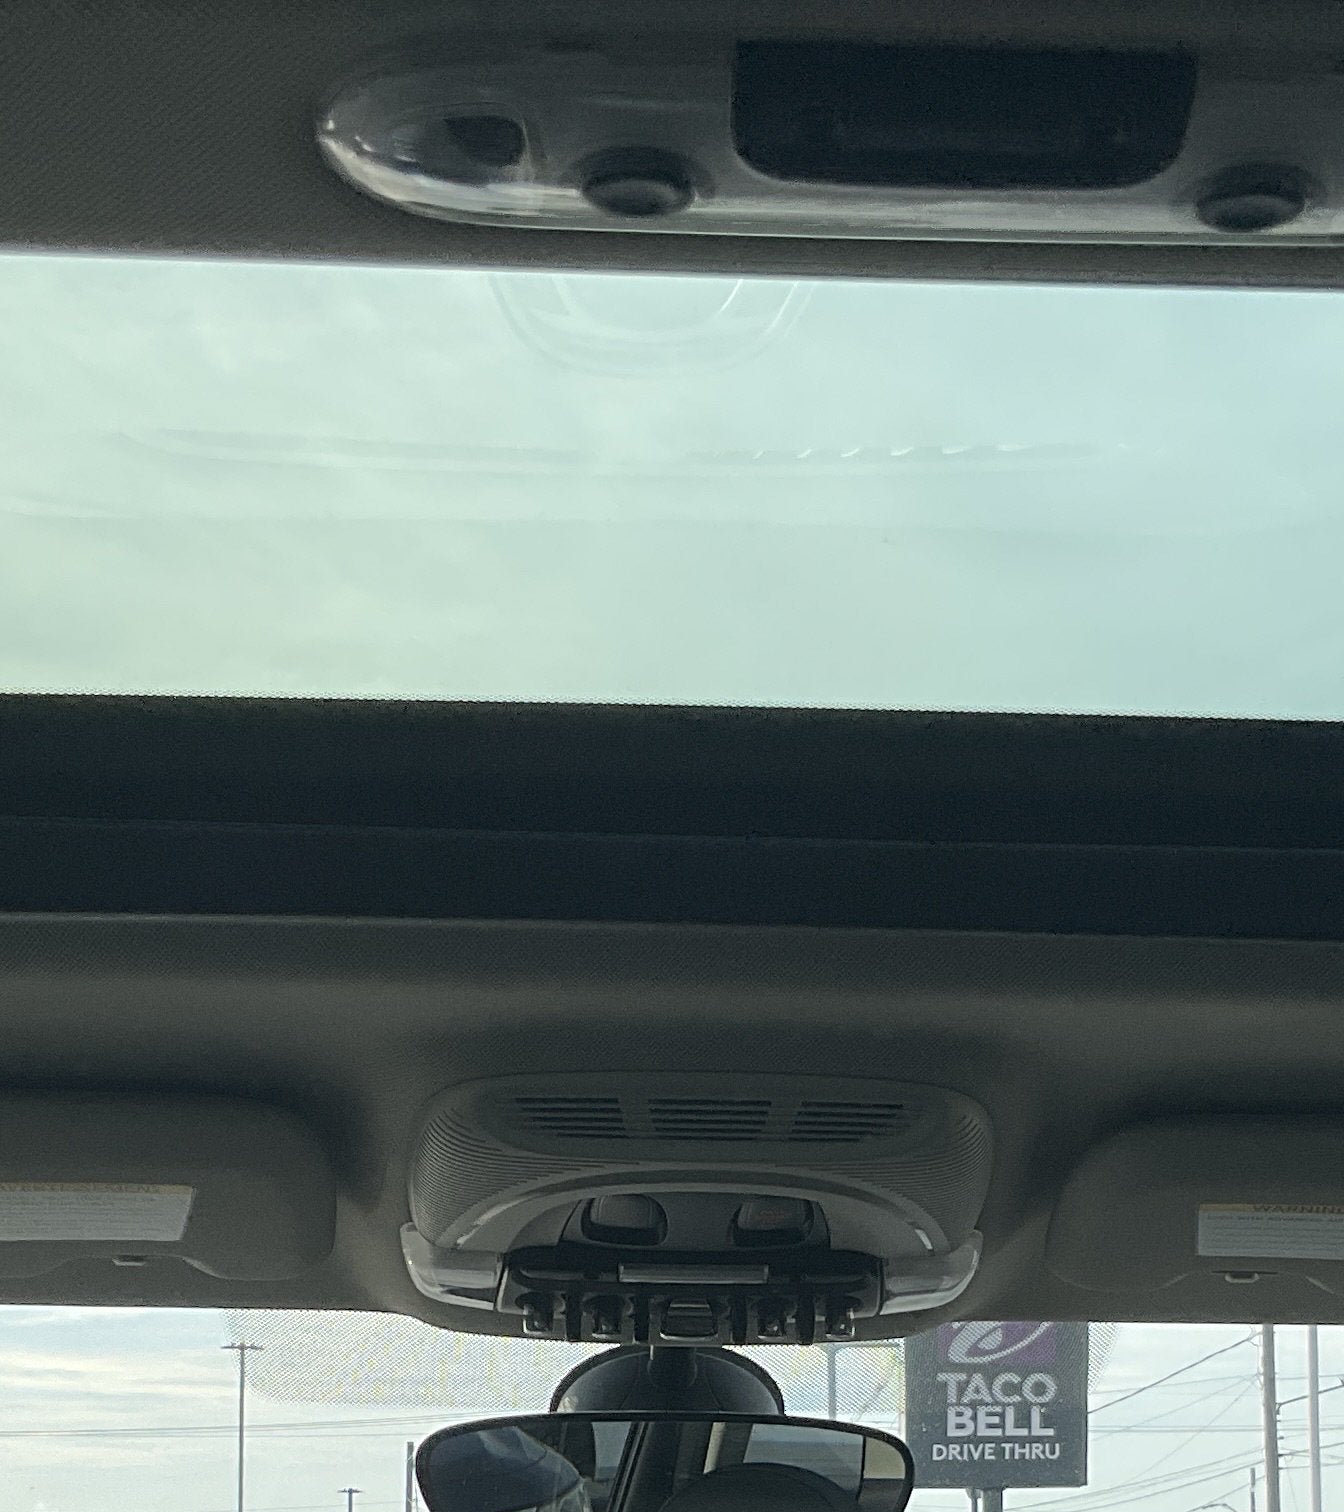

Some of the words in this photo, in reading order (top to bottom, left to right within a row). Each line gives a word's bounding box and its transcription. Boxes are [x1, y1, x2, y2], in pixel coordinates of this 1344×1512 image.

[936, 1372, 1057, 1403] TACO
[946, 1405, 1055, 1437] BELL
[932, 1443, 996, 1461] DRIVE
[1000, 1442, 1061, 1460] THRU
